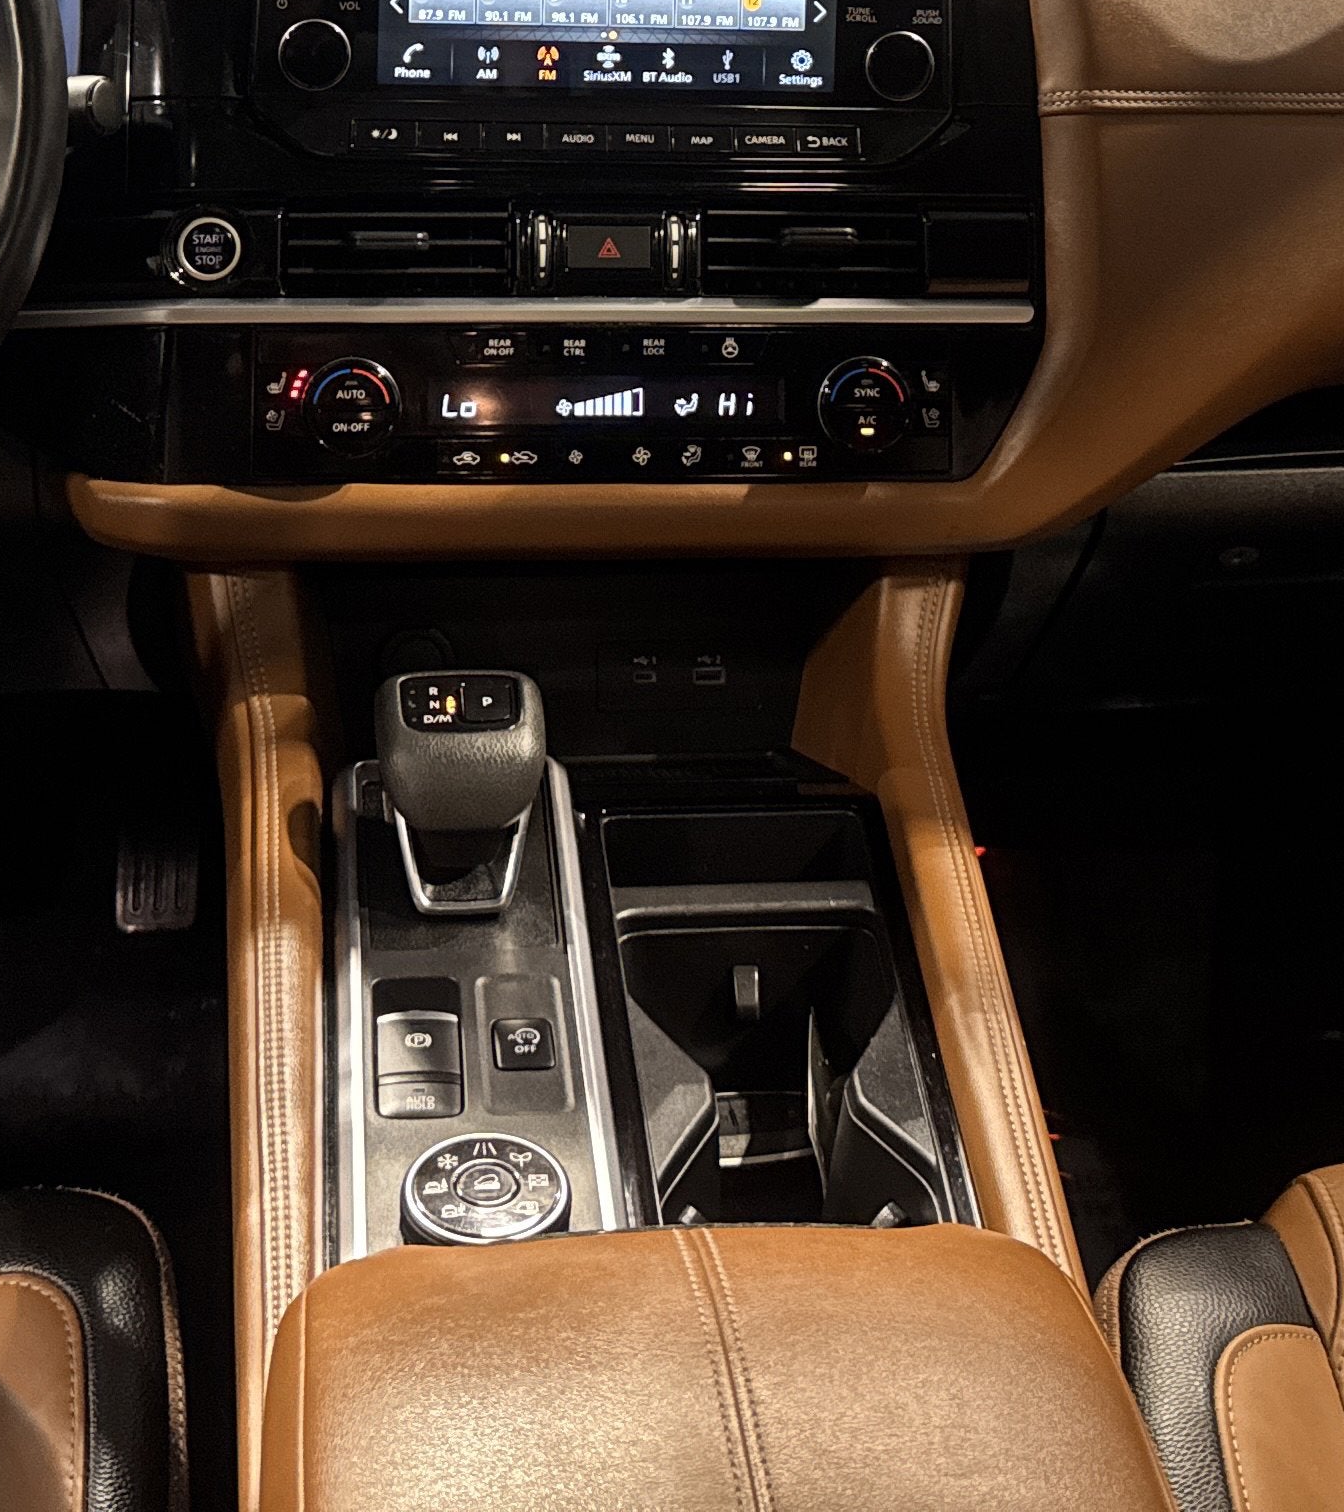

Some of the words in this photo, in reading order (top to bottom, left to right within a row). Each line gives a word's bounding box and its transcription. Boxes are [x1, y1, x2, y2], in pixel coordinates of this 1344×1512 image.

[339, 0, 361, 11] VOL
[447, 9, 466, 21] FM
[484, 10, 509, 22] 90.1
[514, 11, 532, 22] FM
[580, 12, 599, 24] FM
[615, 12, 644, 24] 106.1
[650, 13, 668, 25] FM
[845, 14, 878, 24] SCROLL
[916, 9, 940, 17] PUSH
[681, 14, 712, 26] 107.9
[716, 15, 734, 27] FM
[747, 15, 777, 27] 107.9
[781, 16, 799, 28] FM
[912, 17, 943, 25] SOUND
[393, 66, 431, 80] Phone
[476, 68, 498, 80] AM
[538, 69, 558, 81] FM
[583, 70, 632, 83] SiriusXM
[642, 71, 658, 83] BT
[658, 71, 693, 84] Audio
[712, 72, 740, 84] USB1
[778, 73, 824, 88] Settings
[561, 132, 595, 145] AUDIO
[625, 132, 655, 145] MENU
[690, 134, 714, 146] MAP
[744, 134, 786, 146] CAMERA
[822, 135, 849, 147] BACK
[192, 233, 225, 245] START
[194, 245, 222, 254] ENGINE
[194, 254, 224, 266] STOP
[488, 338, 512, 348] REAR
[563, 339, 586, 348] REAR
[642, 338, 666, 348] REAR
[563, 347, 586, 357] CTRL
[642, 347, 666, 356] LOCK
[336, 389, 367, 400] AUTO
[854, 387, 881, 398] SYNC
[441, 393, 478, 419] Lo
[718, 392, 755, 417] Hi
[857, 414, 877, 425] A/C
[740, 460, 764, 469] FRONT
[799, 459, 818, 468] REAR
[428, 686, 439, 696] R
[429, 700, 440, 710] N
[482, 696, 493, 708] P
[423, 714, 453, 725] D/M
[514, 1044, 538, 1055] OFF
[405, 1095, 436, 1103] AUTO
[405, 1102, 436, 1111] HOLD
